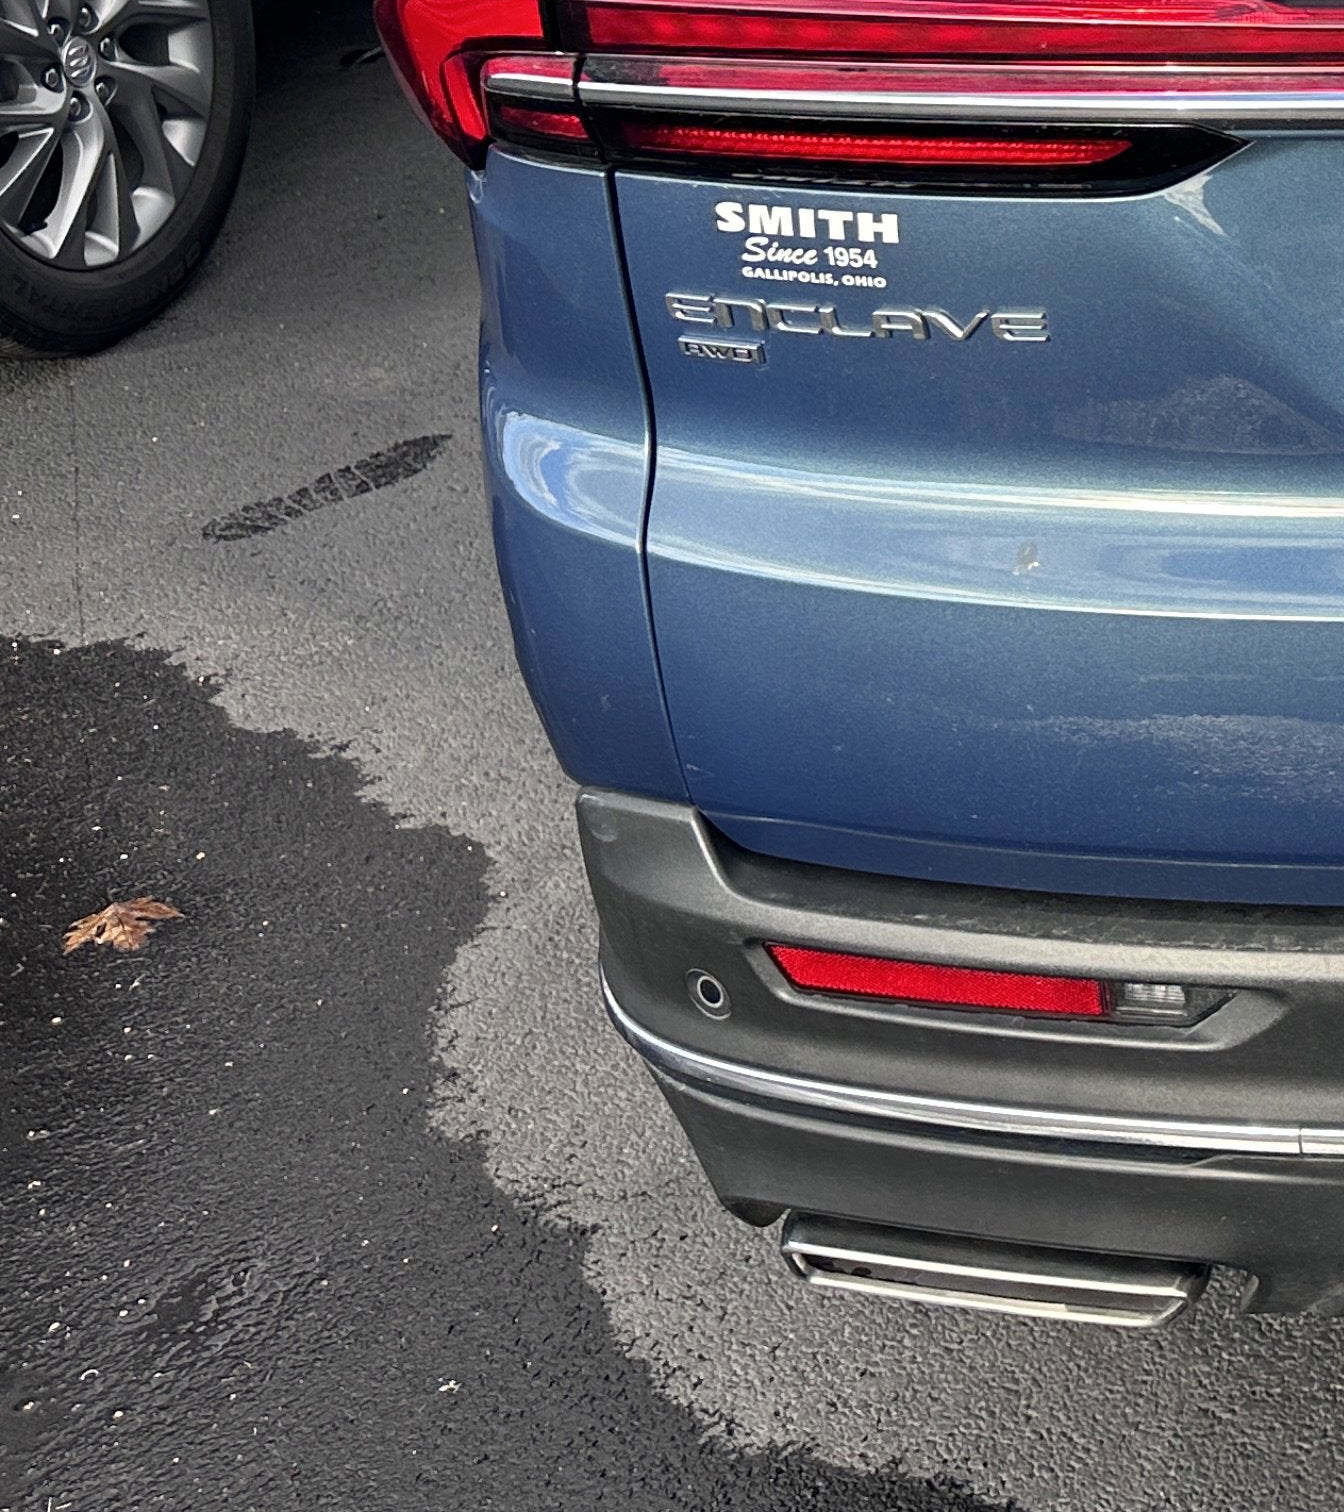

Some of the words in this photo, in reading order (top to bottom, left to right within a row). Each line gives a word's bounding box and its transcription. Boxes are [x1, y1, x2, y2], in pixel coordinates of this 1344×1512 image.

[714, 201, 900, 244] SMITH
[741, 236, 818, 266] Since
[823, 246, 879, 269] 1954
[742, 266, 839, 287] GALLIPOLIS,
[841, 274, 887, 289] OHIO
[665, 292, 1051, 343] ENCLAVE
[680, 341, 758, 364] AWD
